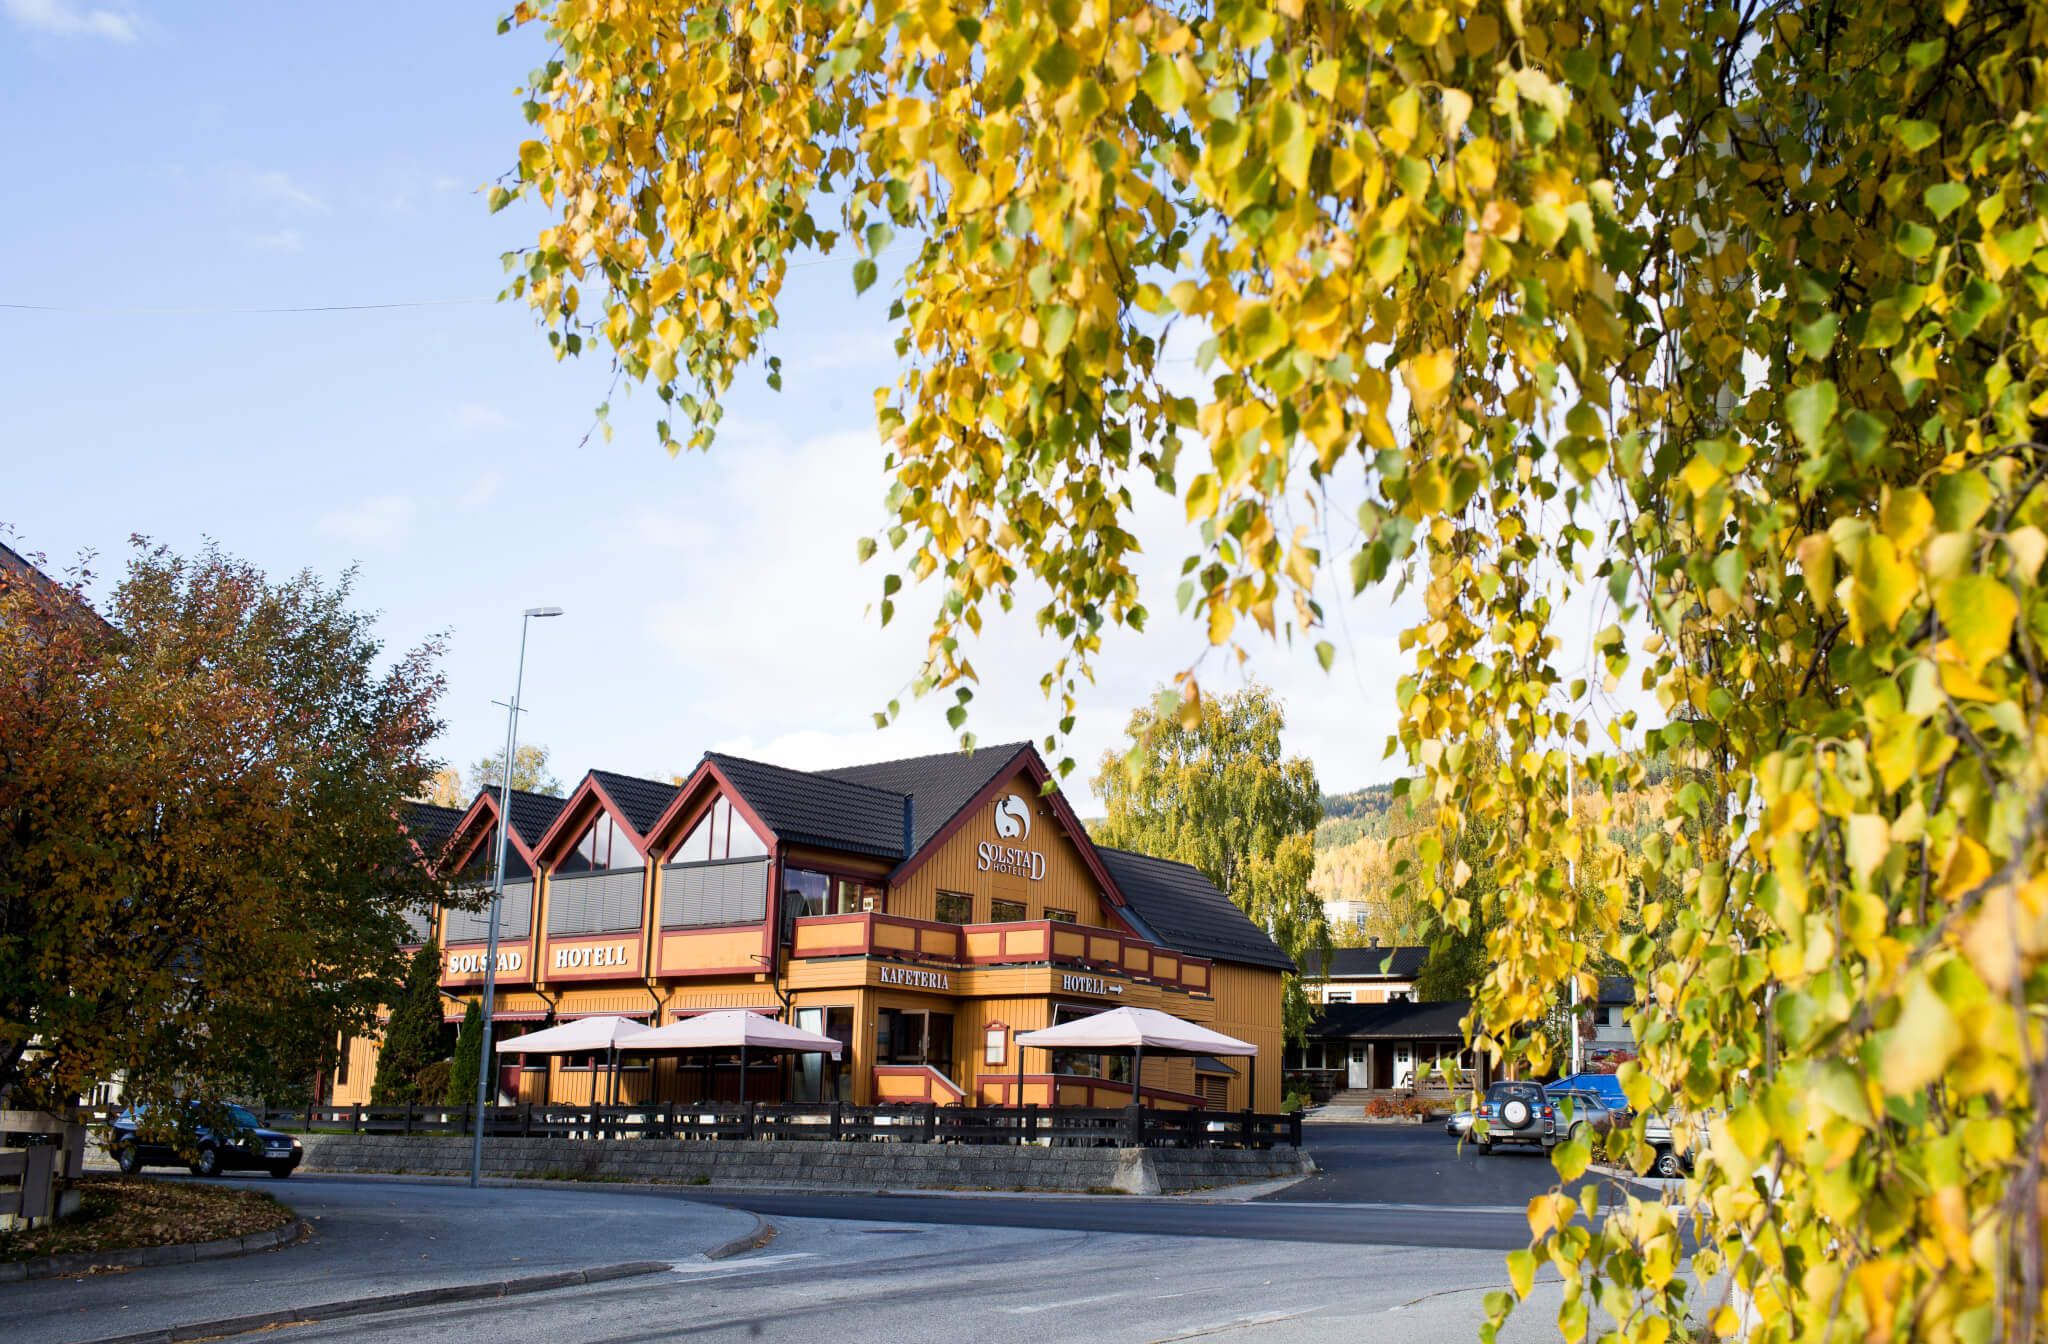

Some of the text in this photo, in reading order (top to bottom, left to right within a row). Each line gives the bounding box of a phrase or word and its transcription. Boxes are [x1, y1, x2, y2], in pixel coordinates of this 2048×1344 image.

[978, 841, 1046, 881] SOLSTAD
[993, 863, 1026, 877] HOTELL
[449, 944, 628, 974] SOLSAD HOTELL
[880, 966, 949, 990] KAFETERIA
[1063, 974, 1107, 995] HOTELL
